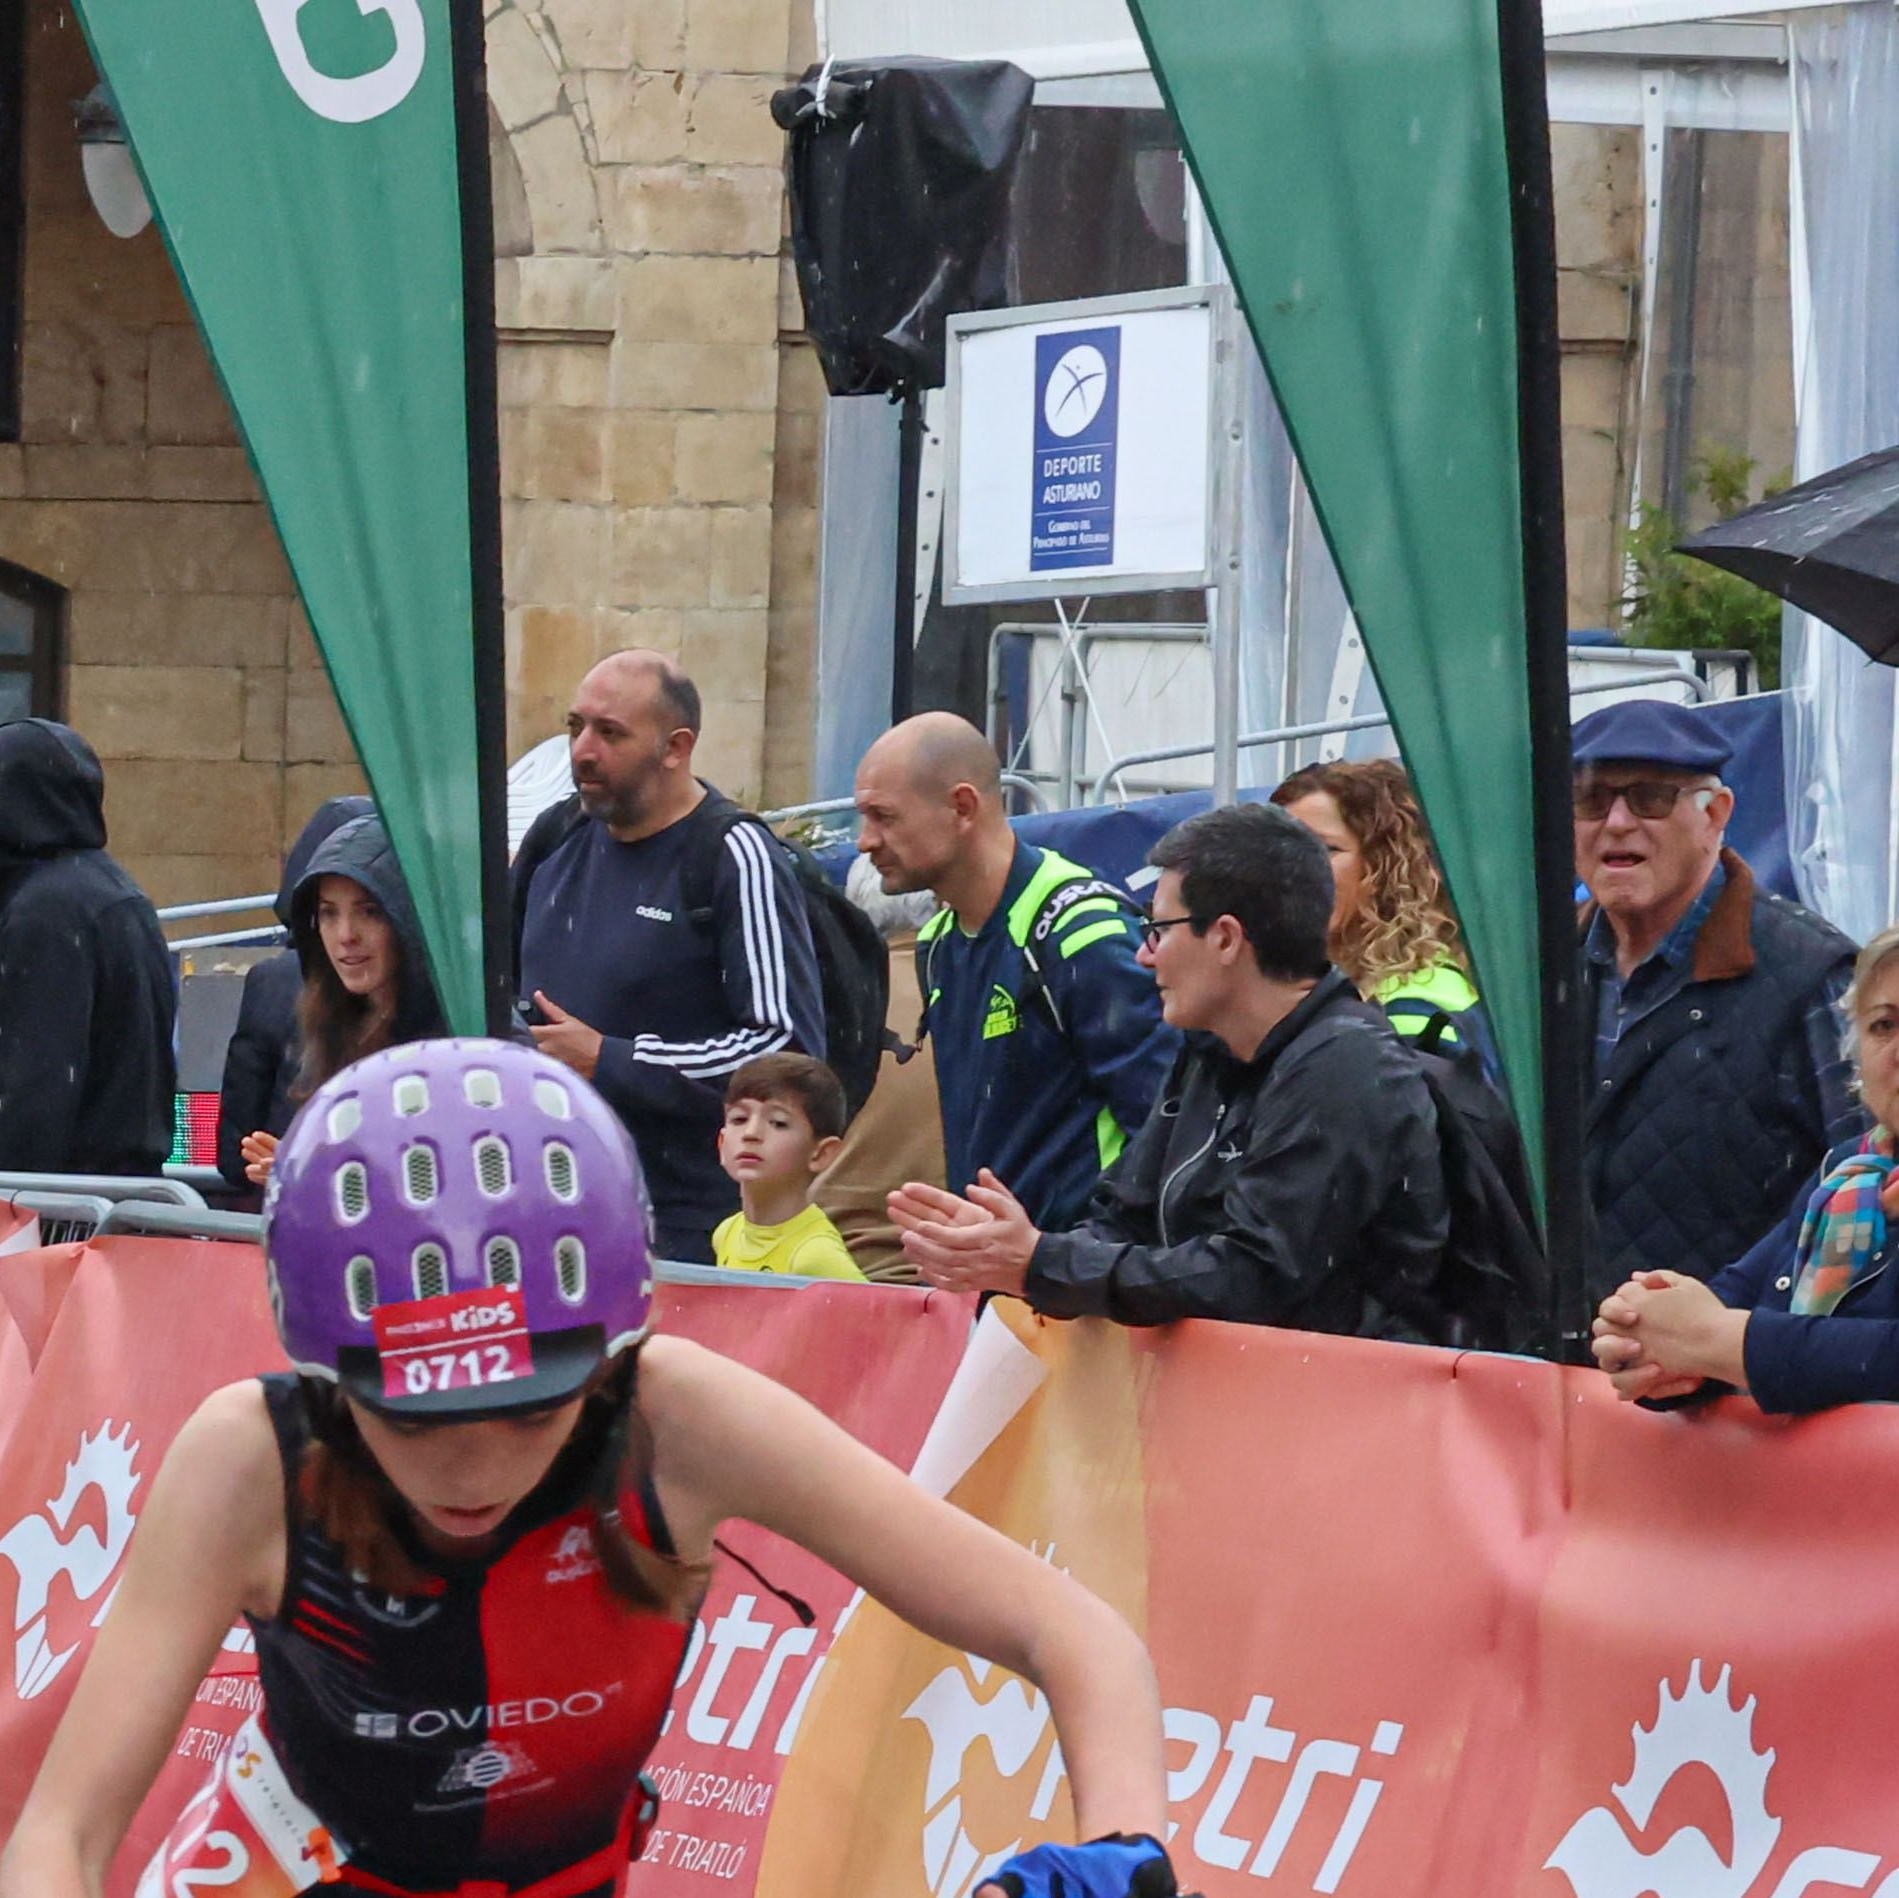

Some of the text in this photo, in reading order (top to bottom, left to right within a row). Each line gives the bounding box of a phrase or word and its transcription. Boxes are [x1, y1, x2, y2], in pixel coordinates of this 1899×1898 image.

[1043, 454, 1102, 478] DEPORTE
[1043, 481, 1101, 504] ASTURIANO
[635, 905, 673, 922] adidas
[404, 1345, 516, 1395] 0712
[407, 1691, 604, 1737] OVIEDO
[668, 1832, 749, 1880] TRIATLÓ
